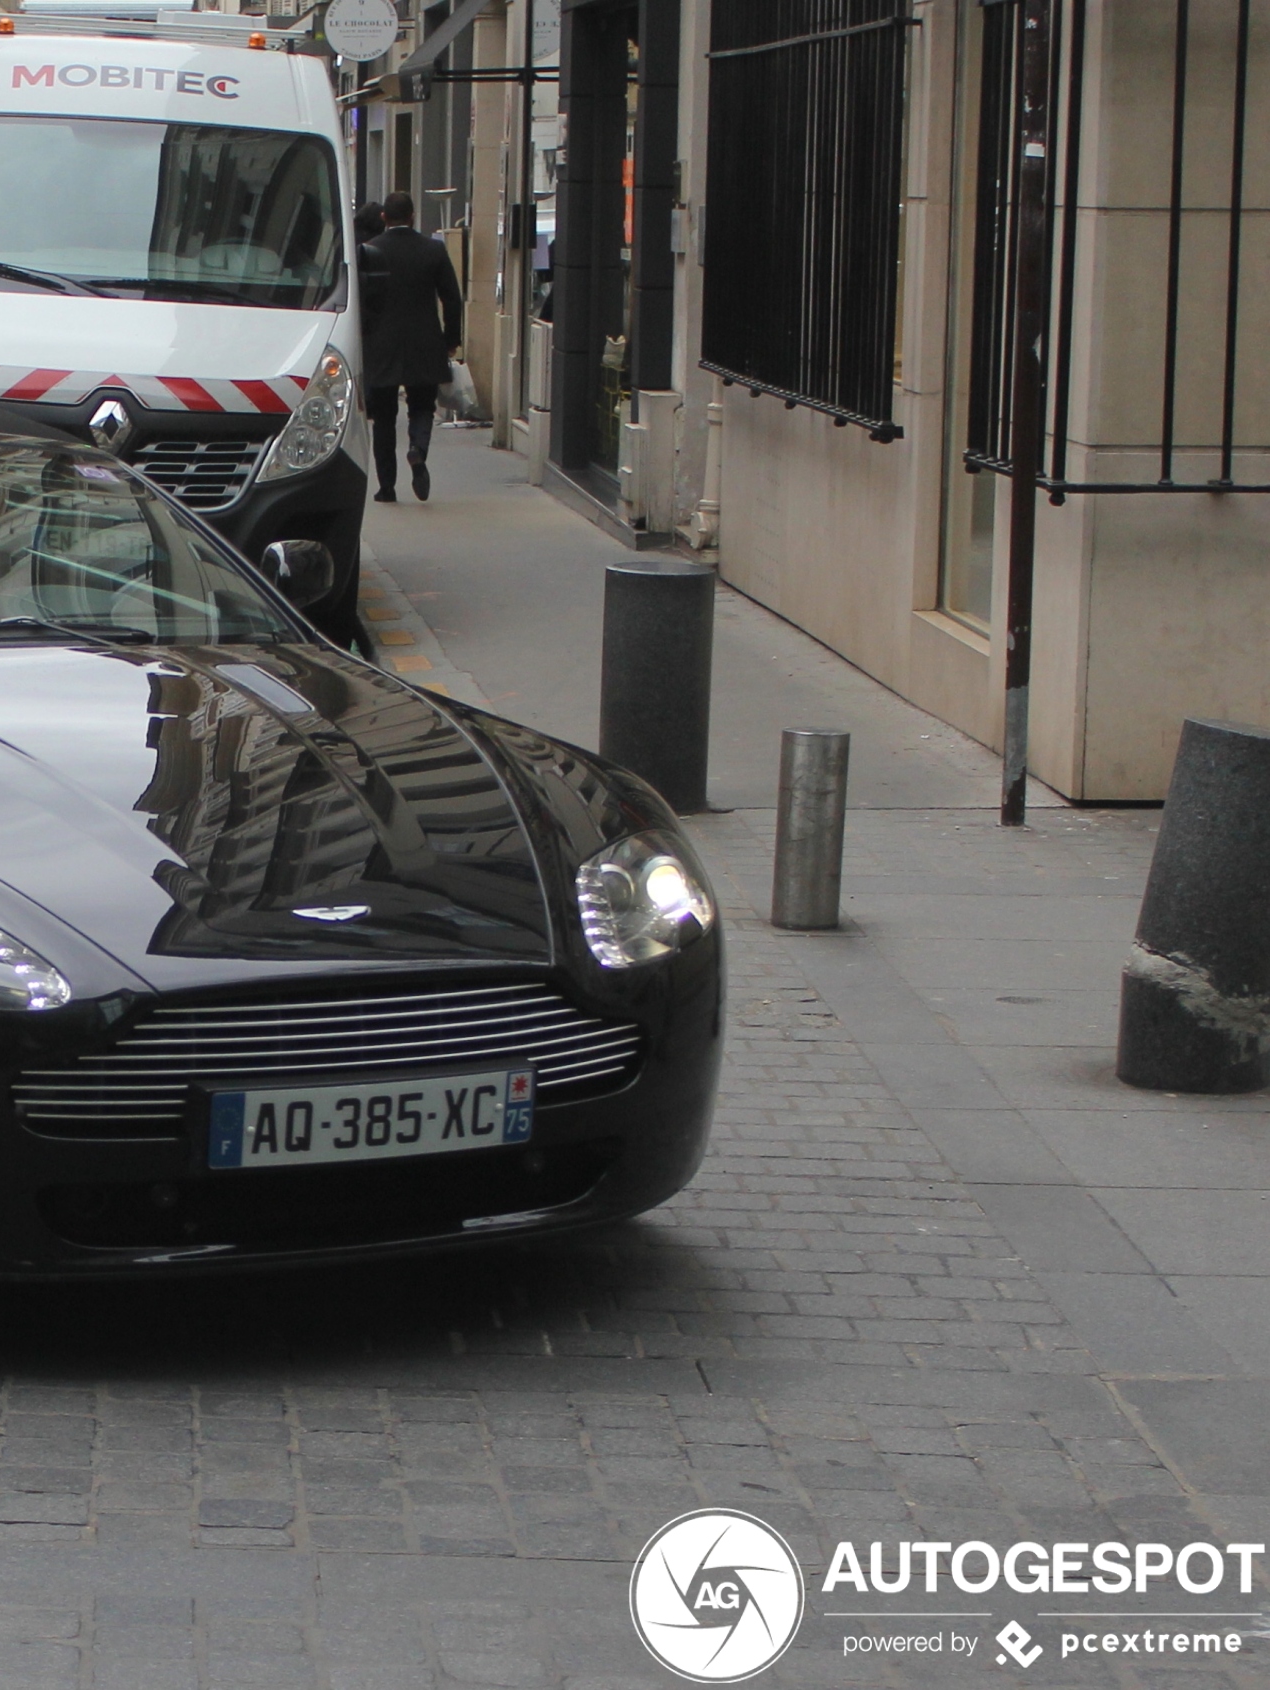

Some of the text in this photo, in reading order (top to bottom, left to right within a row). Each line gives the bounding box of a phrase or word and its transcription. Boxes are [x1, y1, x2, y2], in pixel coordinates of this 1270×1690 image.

[12, 64, 240, 99] MOBITEC
[221, 1085, 529, 1155] F AQ-385-XC 75
